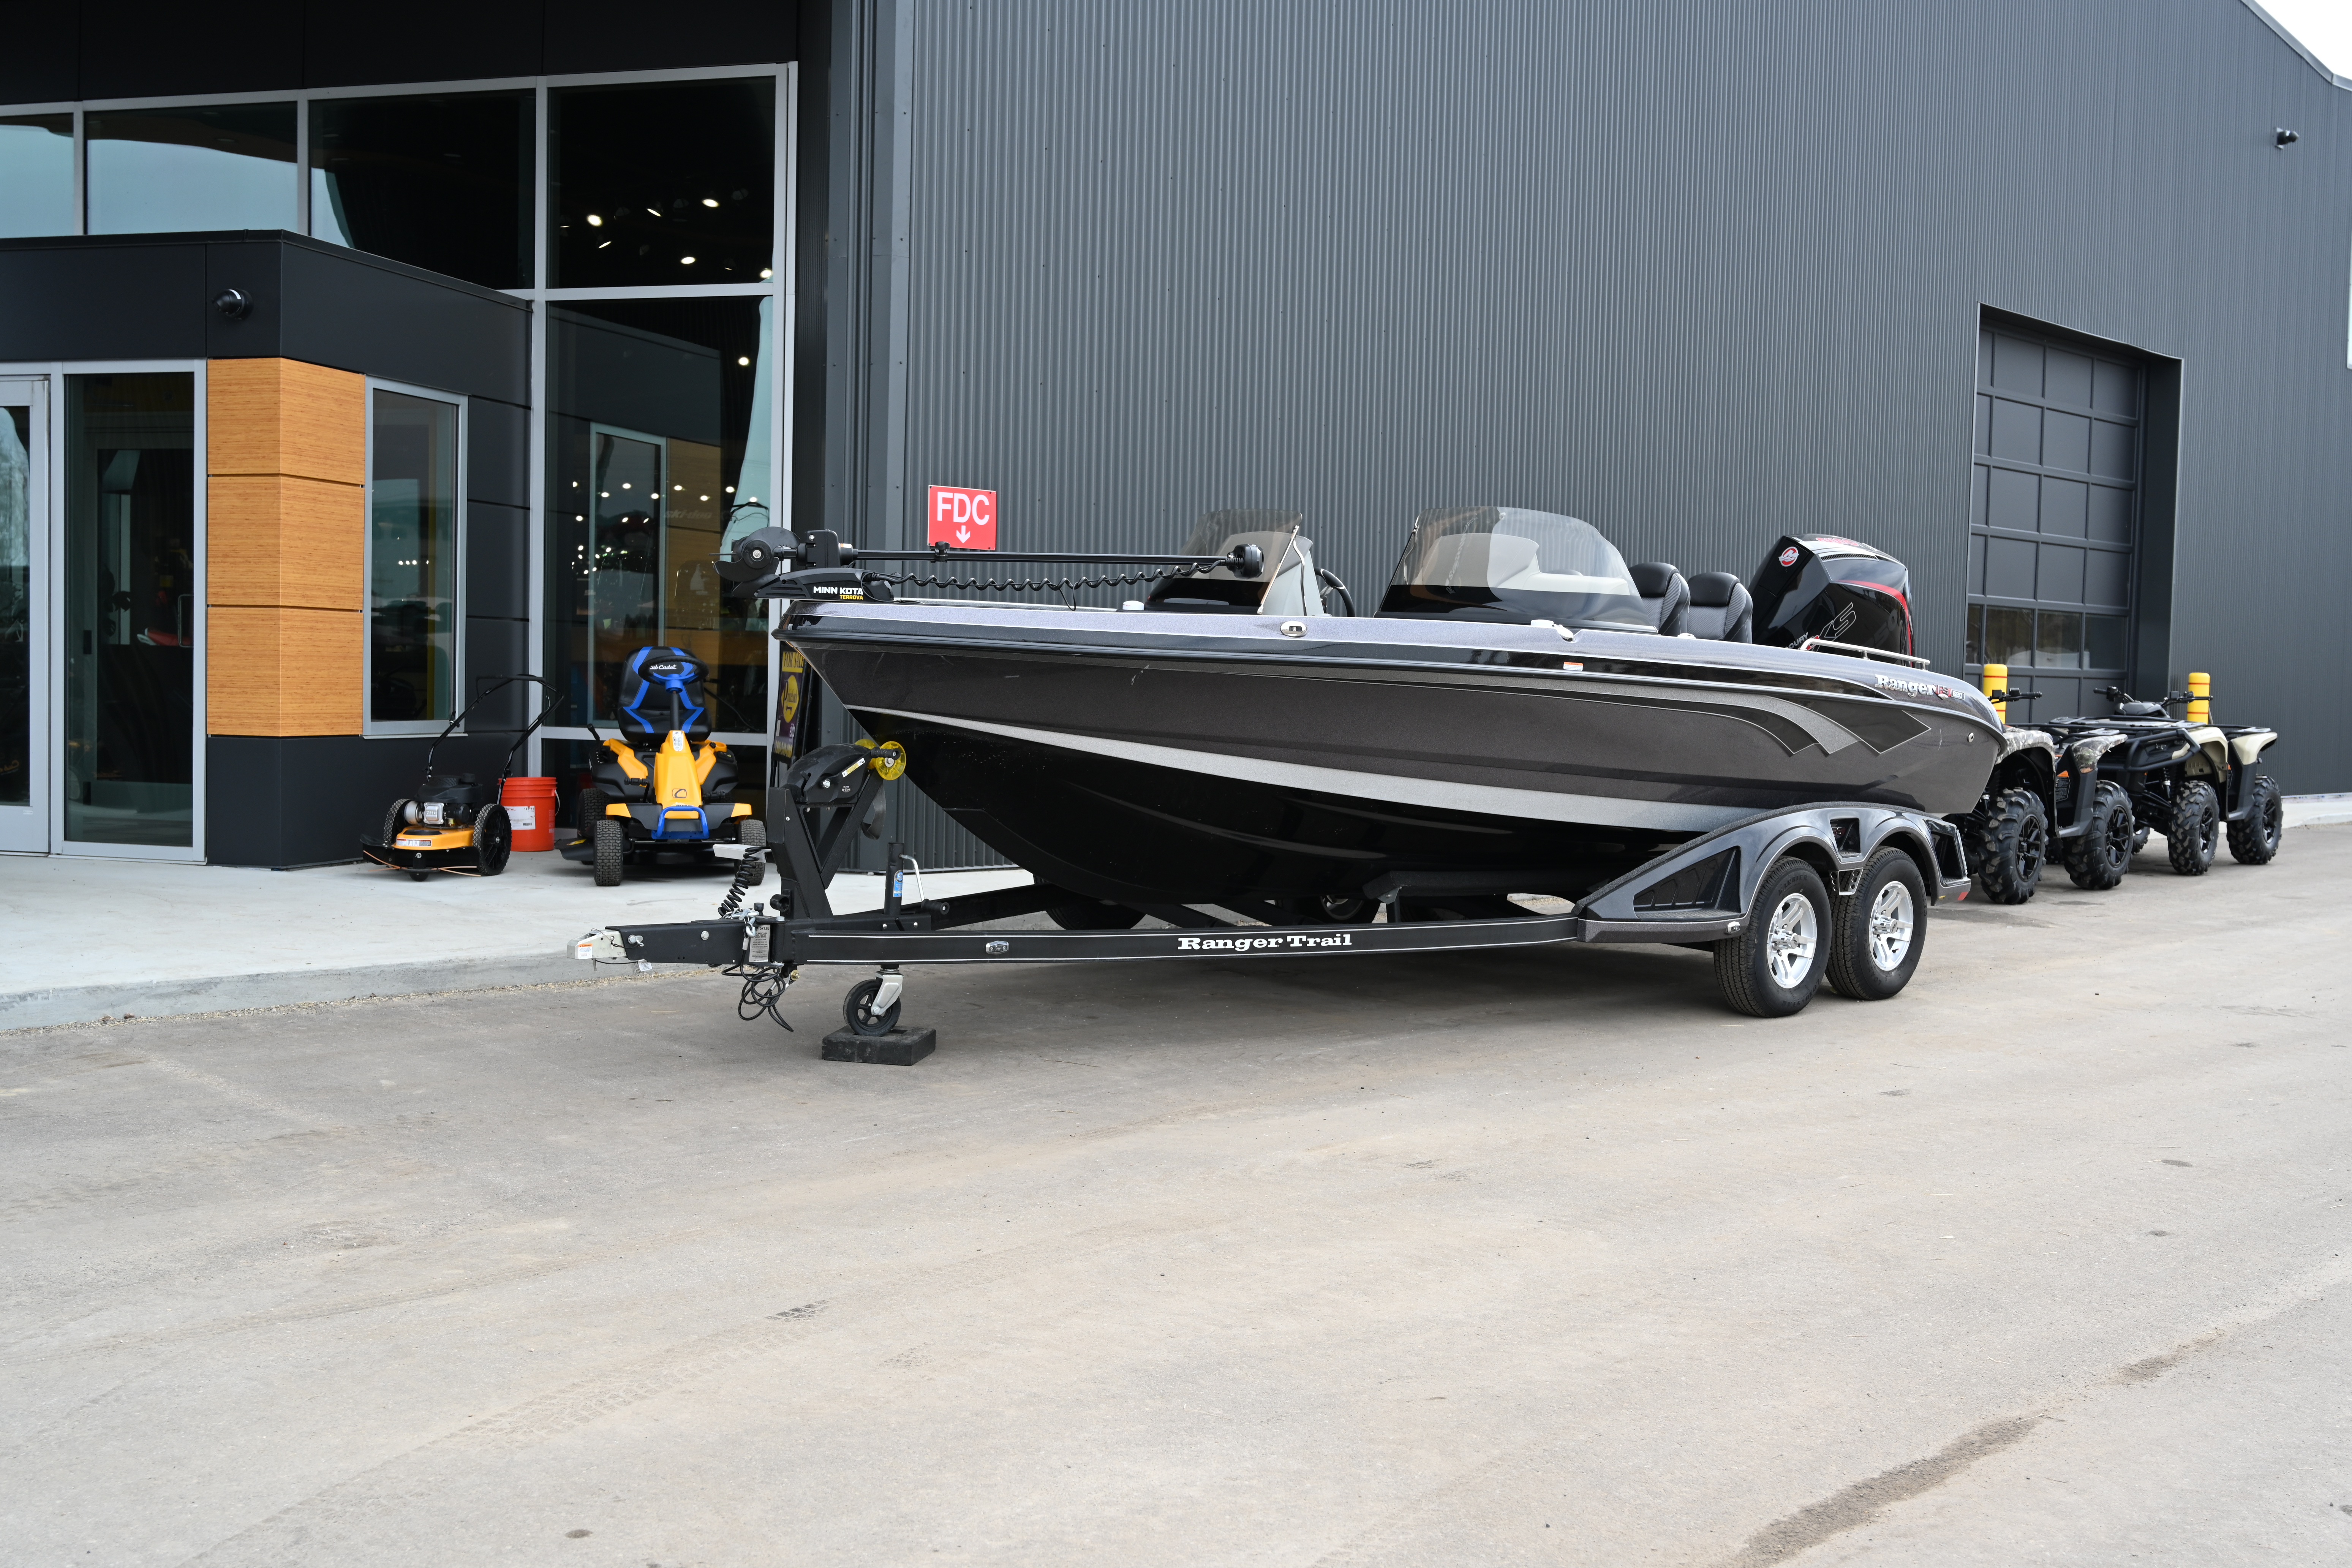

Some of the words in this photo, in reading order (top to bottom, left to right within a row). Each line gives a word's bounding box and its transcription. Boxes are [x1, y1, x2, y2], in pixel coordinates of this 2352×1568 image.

[937, 492, 989, 525] FDC
[1785, 632, 1808, 649] CURY
[784, 652, 793, 667] FOR
[1875, 674, 1936, 698] Ranger
[1938, 685, 1949, 694] FS
[1178, 937, 1283, 951] Ranger
[1287, 934, 1352, 947] Trail
